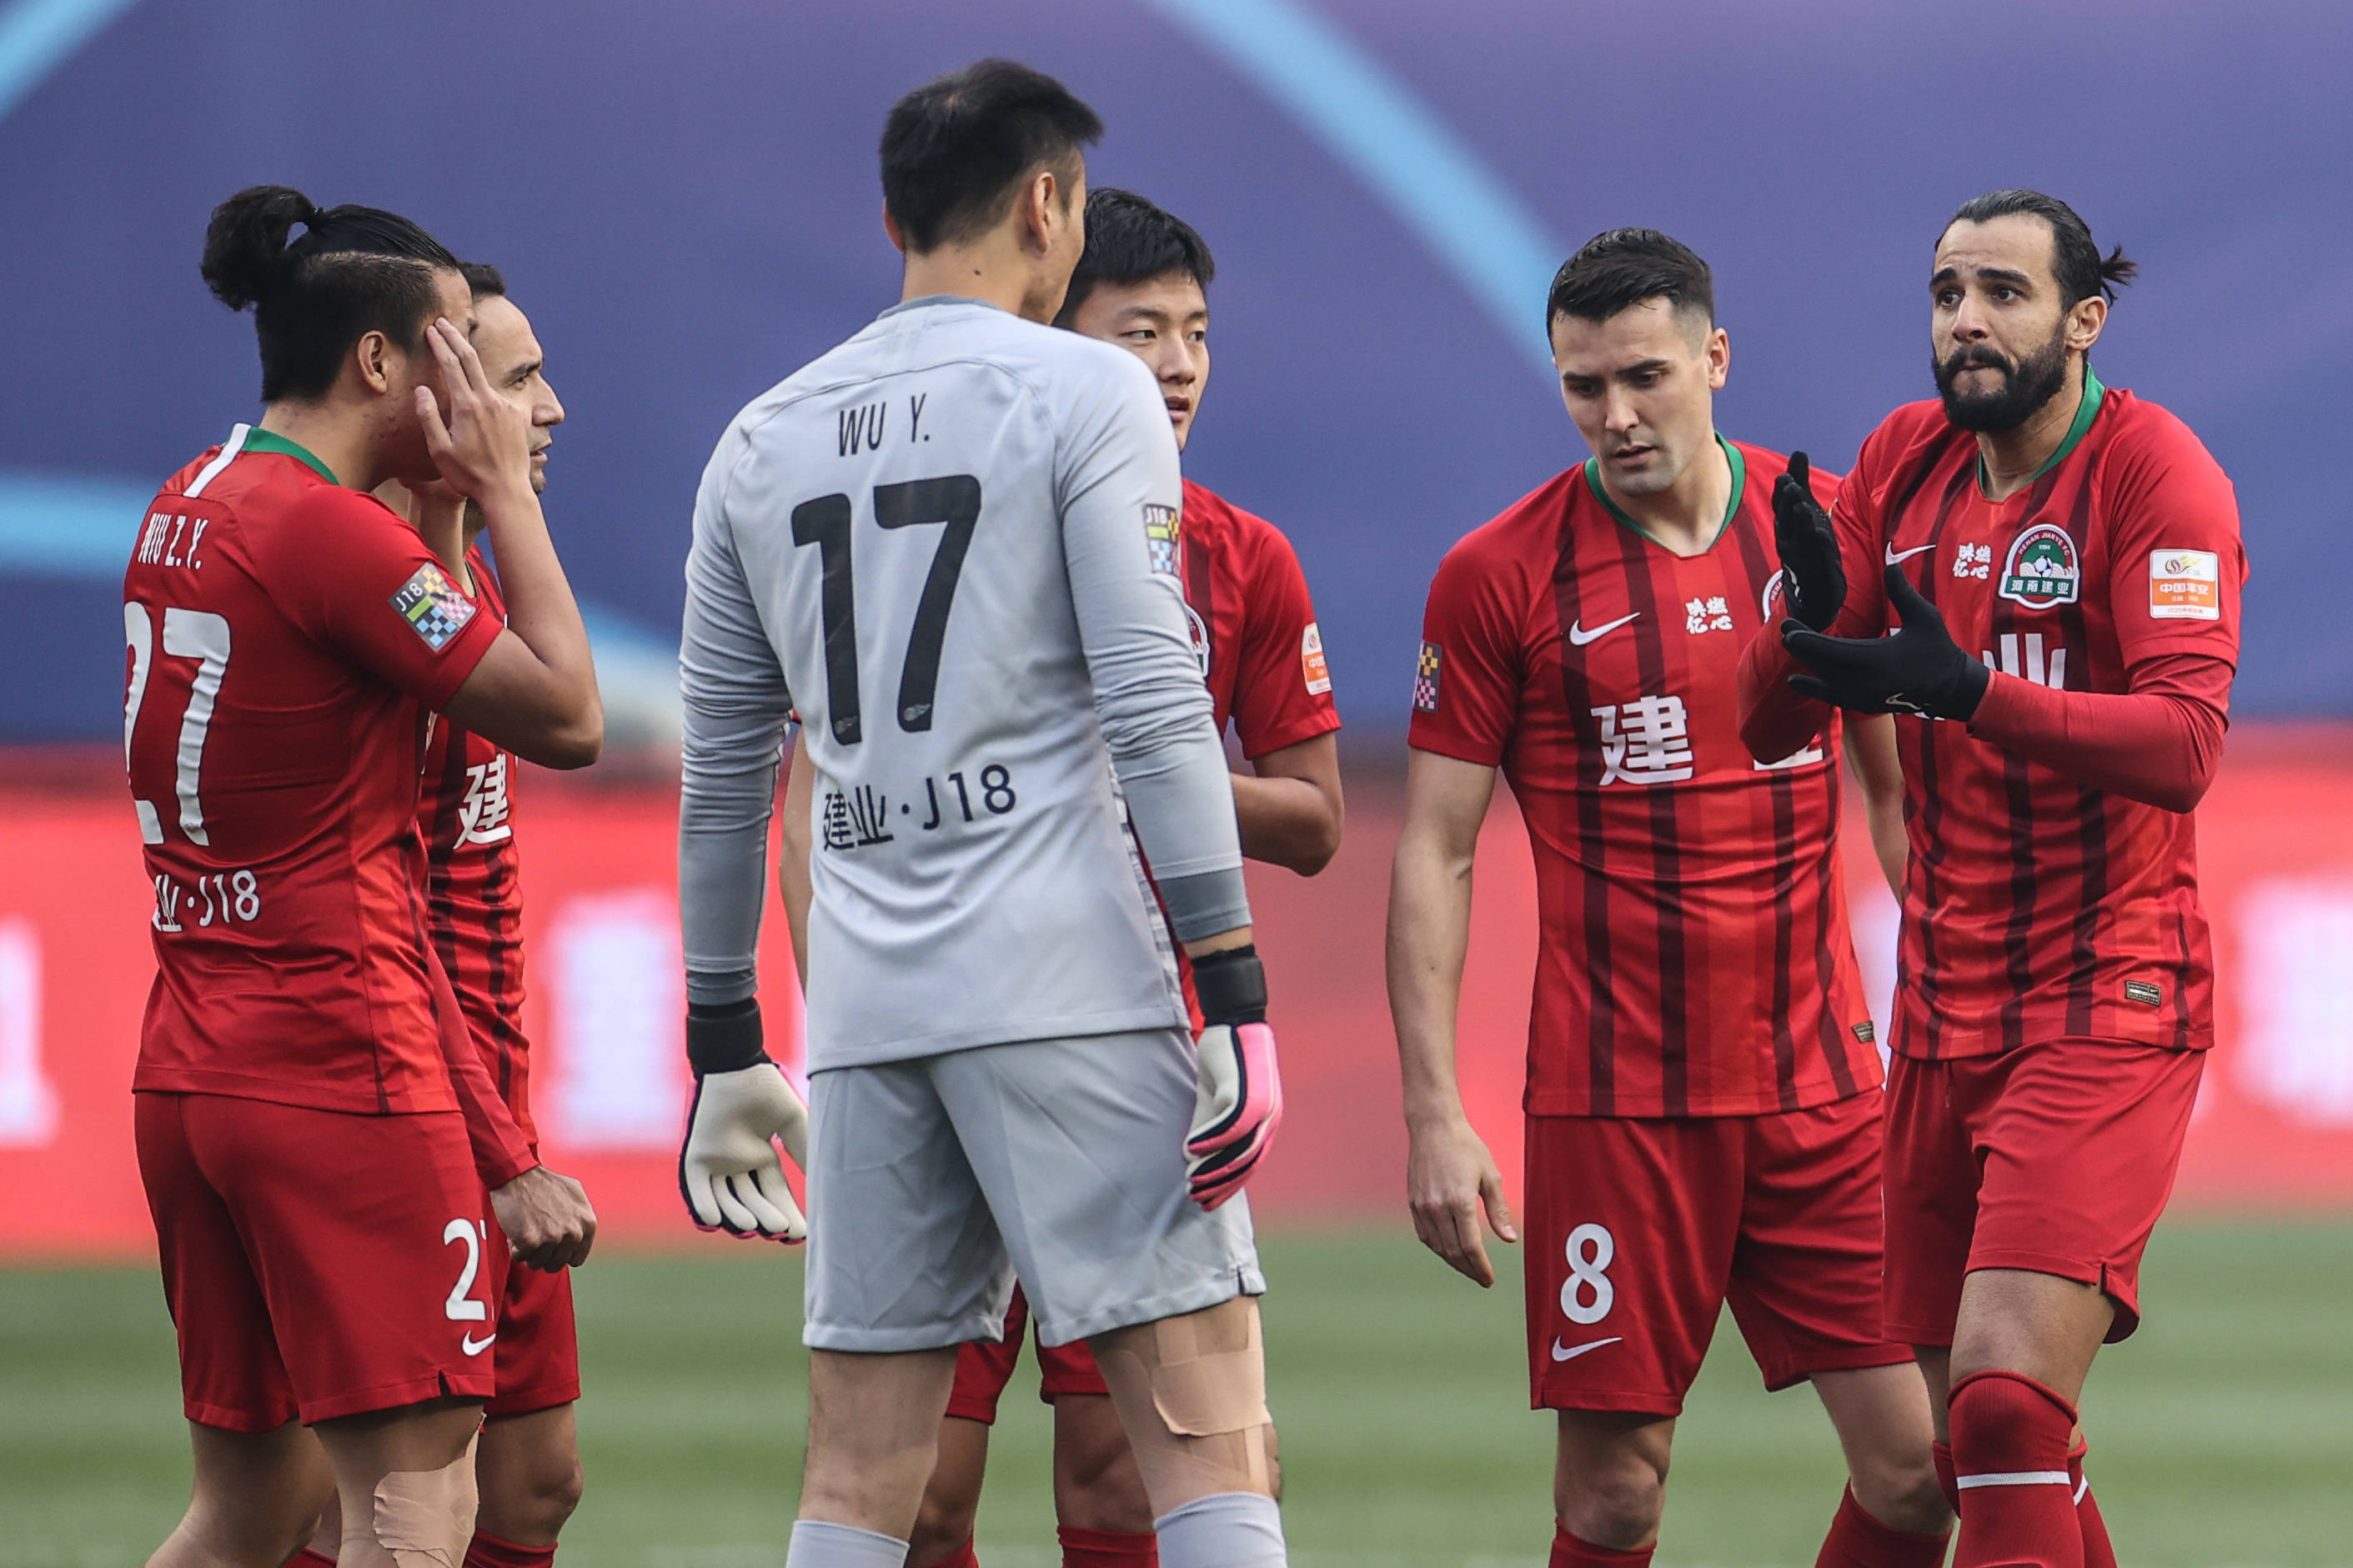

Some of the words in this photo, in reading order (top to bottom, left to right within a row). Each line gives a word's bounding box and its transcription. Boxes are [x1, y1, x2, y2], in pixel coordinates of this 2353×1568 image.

[838, 402, 887, 457] WU
[910, 393, 931, 443] Y.
[1146, 507, 1168, 525] J18
[138, 513, 173, 565] NIU
[2018, 534, 2040, 555] HENAN
[395, 582, 424, 613] J18
[2010, 579, 2070, 595] 河南建业
[2159, 582, 2210, 595] 中国平安
[790, 473, 982, 746] 17
[444, 1217, 494, 1322] 2
[1560, 1222, 1615, 1325] 8
